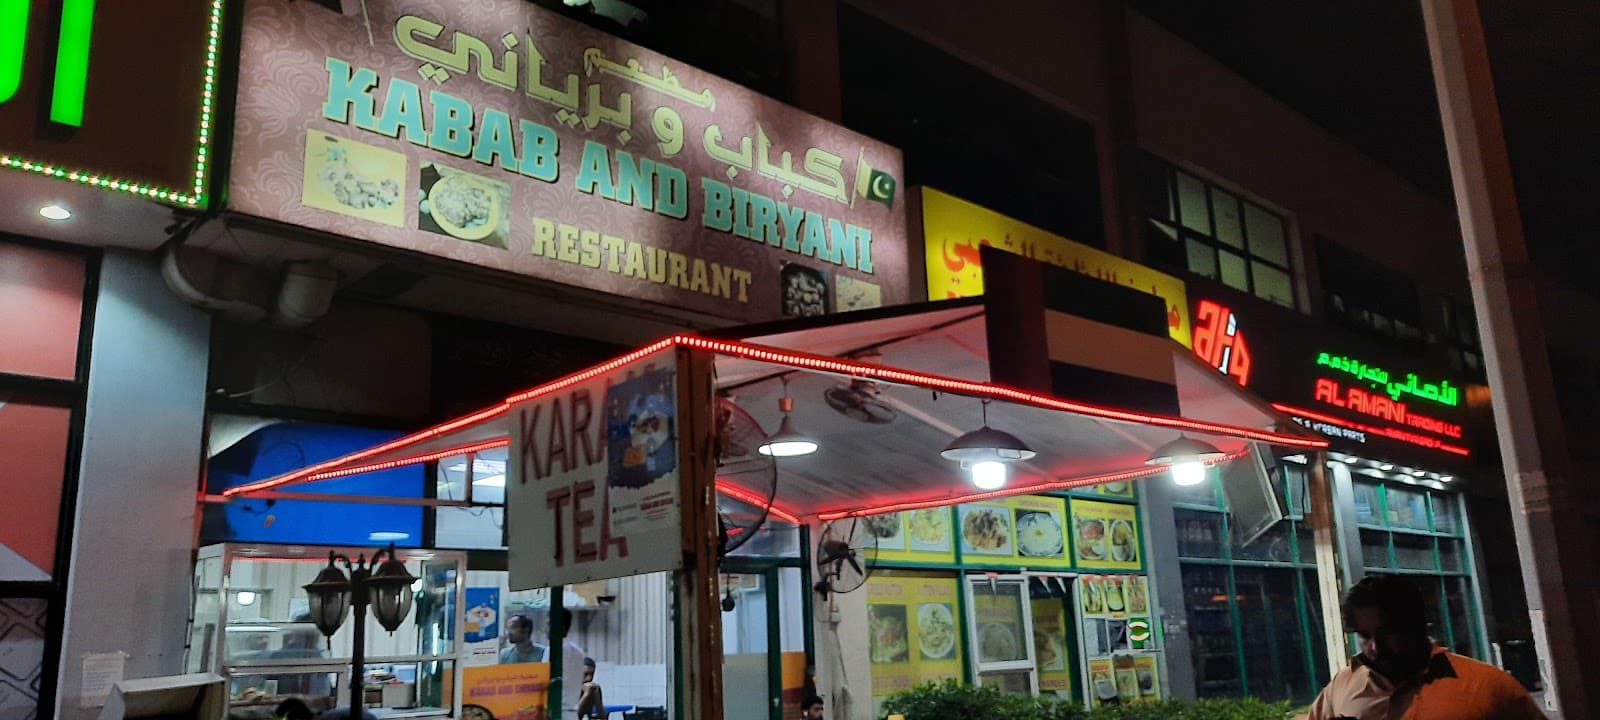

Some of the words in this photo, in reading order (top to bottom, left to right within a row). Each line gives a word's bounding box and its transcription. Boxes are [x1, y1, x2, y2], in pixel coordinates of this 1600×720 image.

[394, 14, 633, 146] برياني
[583, 46, 716, 112] مطعم
[322, 56, 561, 185] KABAB
[575, 140, 690, 222] AND
[701, 176, 876, 275] BIRYANI
[650, 106, 686, 158] و
[703, 122, 850, 205] كباب
[531, 216, 753, 304] RESTAURANT
[1315, 378, 1345, 407] AL
[1348, 388, 1406, 424] AMANI
[547, 480, 629, 568] TEA
